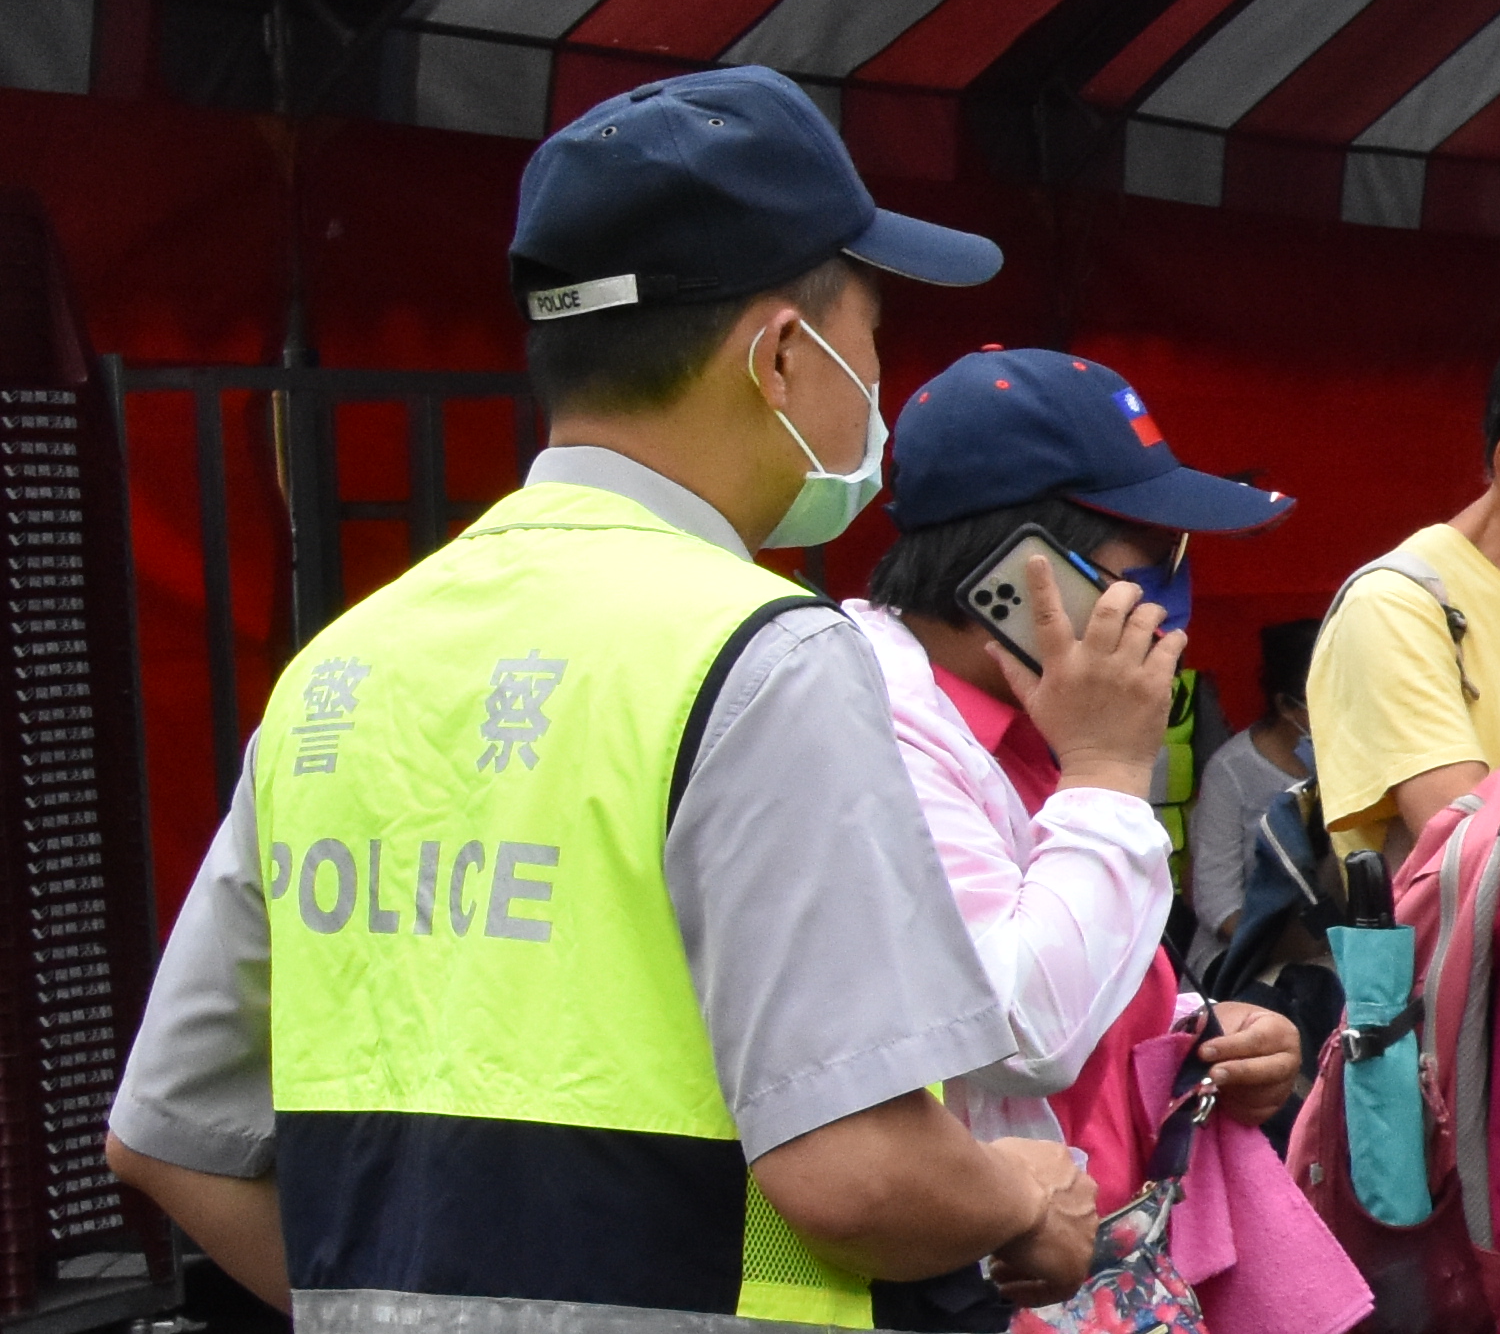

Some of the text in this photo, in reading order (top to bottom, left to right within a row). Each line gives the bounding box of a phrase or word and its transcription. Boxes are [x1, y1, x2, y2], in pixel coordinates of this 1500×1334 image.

[537, 290, 581, 314] POLICE
[292, 648, 569, 777] 警察
[272, 838, 560, 943] POLICE
